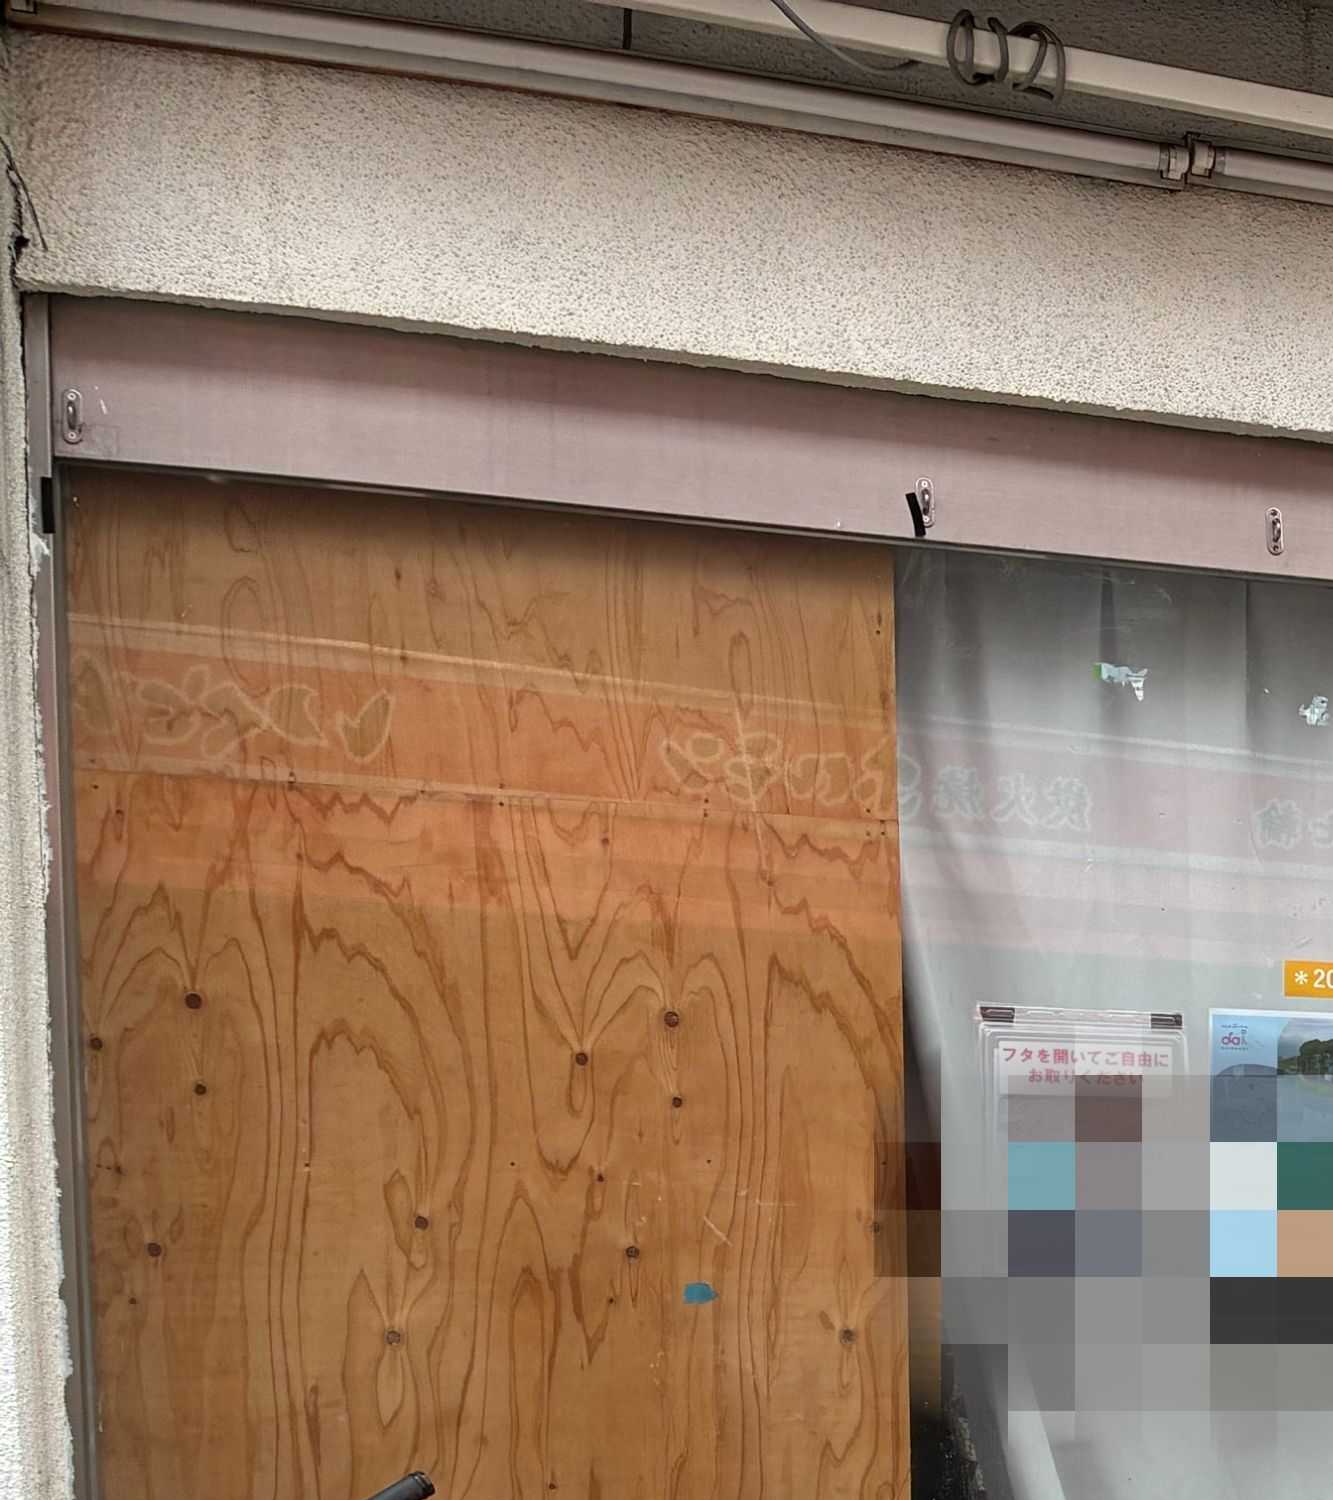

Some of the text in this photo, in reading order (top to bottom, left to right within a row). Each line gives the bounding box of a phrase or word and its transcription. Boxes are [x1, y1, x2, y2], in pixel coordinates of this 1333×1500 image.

[1002, 1047, 1169, 1068] フタを開いてご自由に
